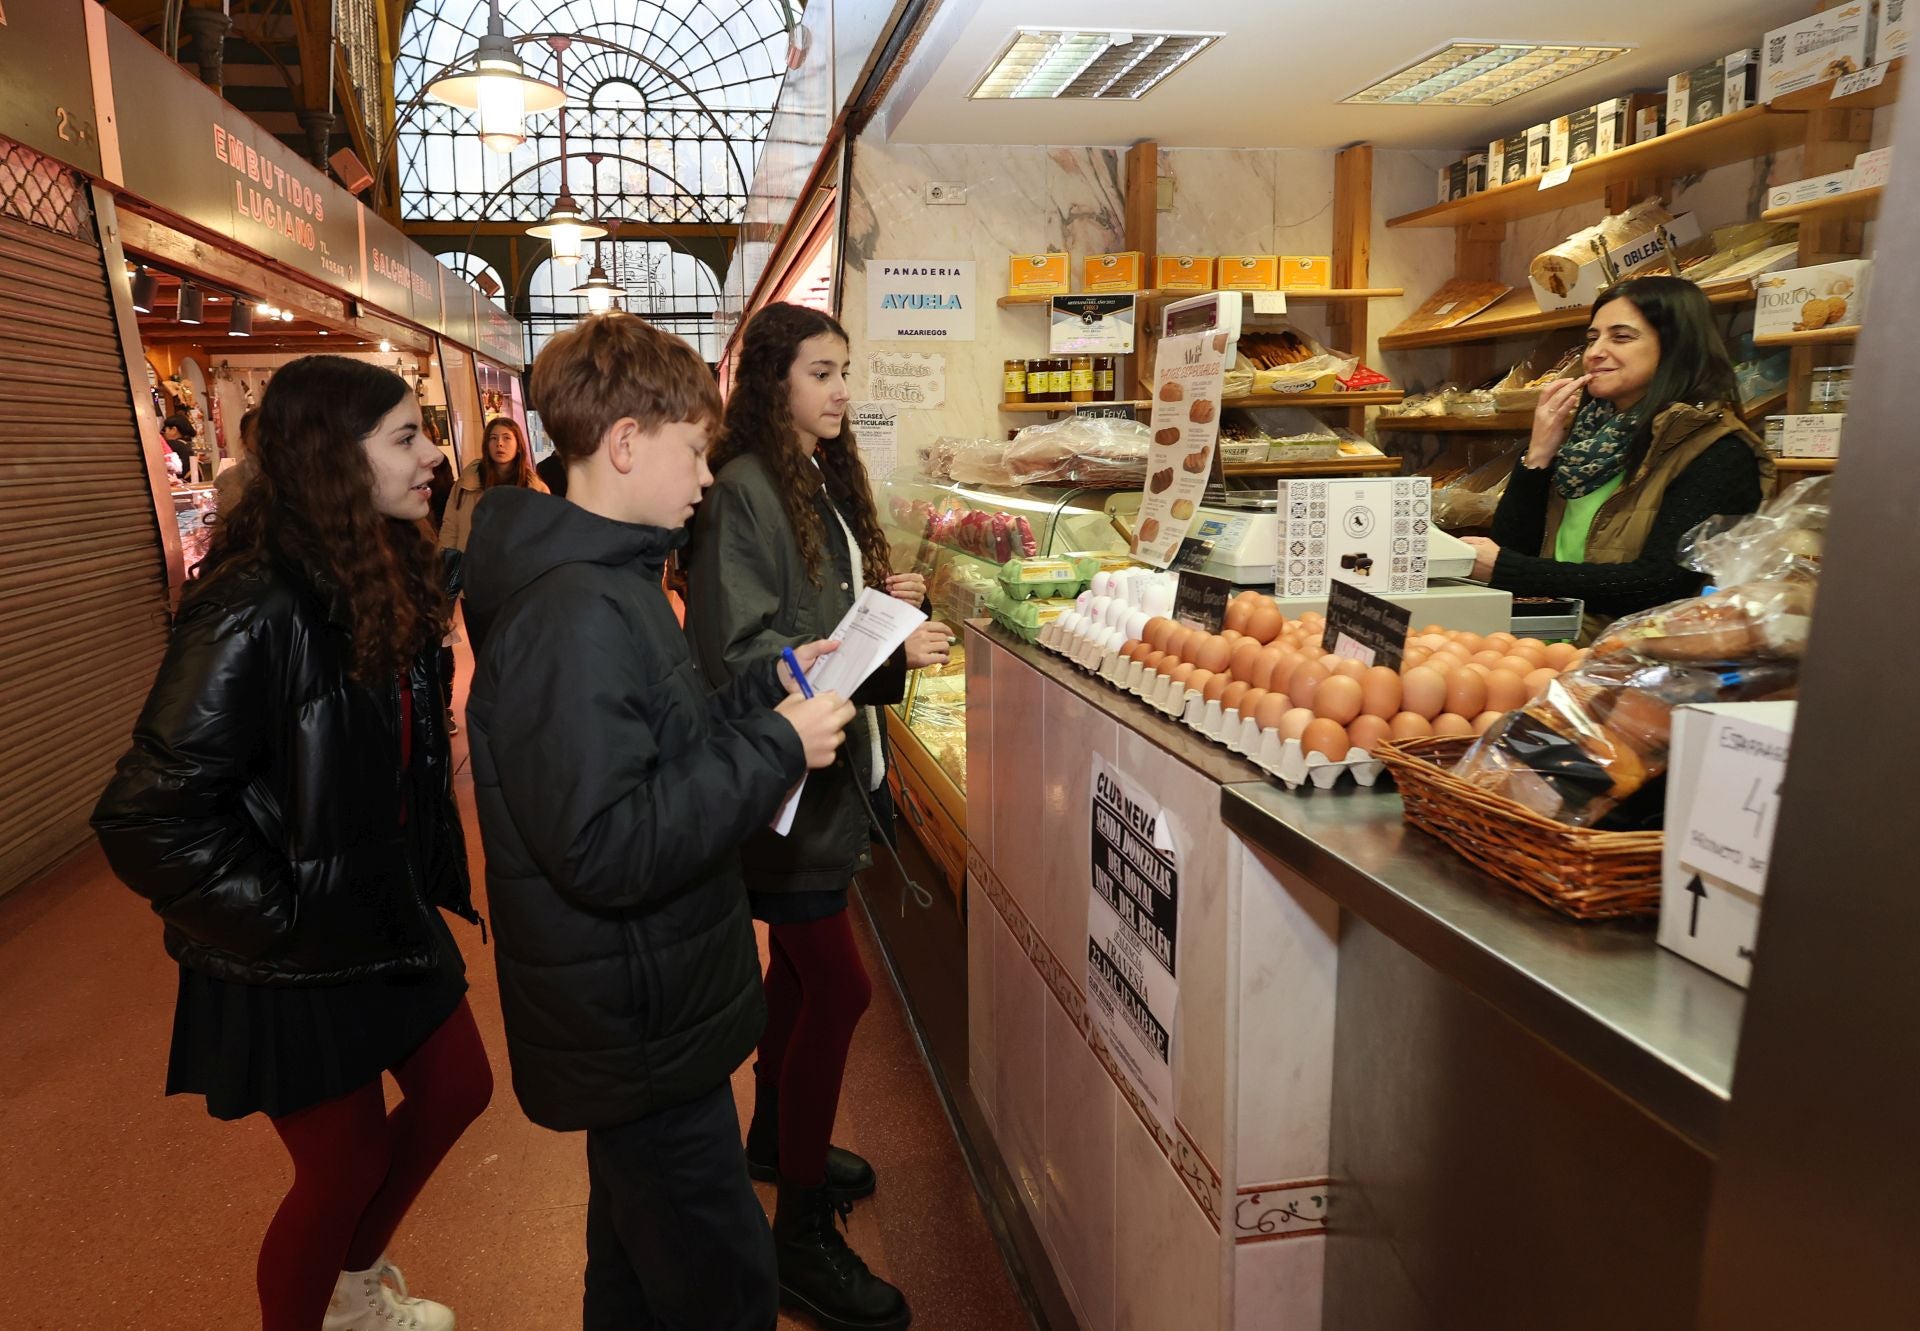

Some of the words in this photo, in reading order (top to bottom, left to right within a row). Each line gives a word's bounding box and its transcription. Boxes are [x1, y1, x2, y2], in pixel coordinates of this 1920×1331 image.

[213, 123, 325, 222] EMBUTIDOS
[235, 179, 316, 251] LUCIANO
[884, 267, 961, 276] PANADERIA
[1623, 239, 1665, 267] OBLEAS
[880, 293, 962, 310] AYUELA
[1761, 288, 1817, 309] TORTOS
[1097, 772, 1122, 811] CLUB
[1096, 806, 1121, 846] SENDA
[1122, 828, 1172, 896] DONCELLAS
[1107, 847, 1123, 881] DEL
[1119, 889, 1138, 931] DEL
[1139, 909, 1172, 968] BELÉN
[1105, 937, 1149, 1004] TRAVESÍA
[1090, 944, 1102, 968] 22
[1102, 957, 1166, 1051] DICIEMBRE
